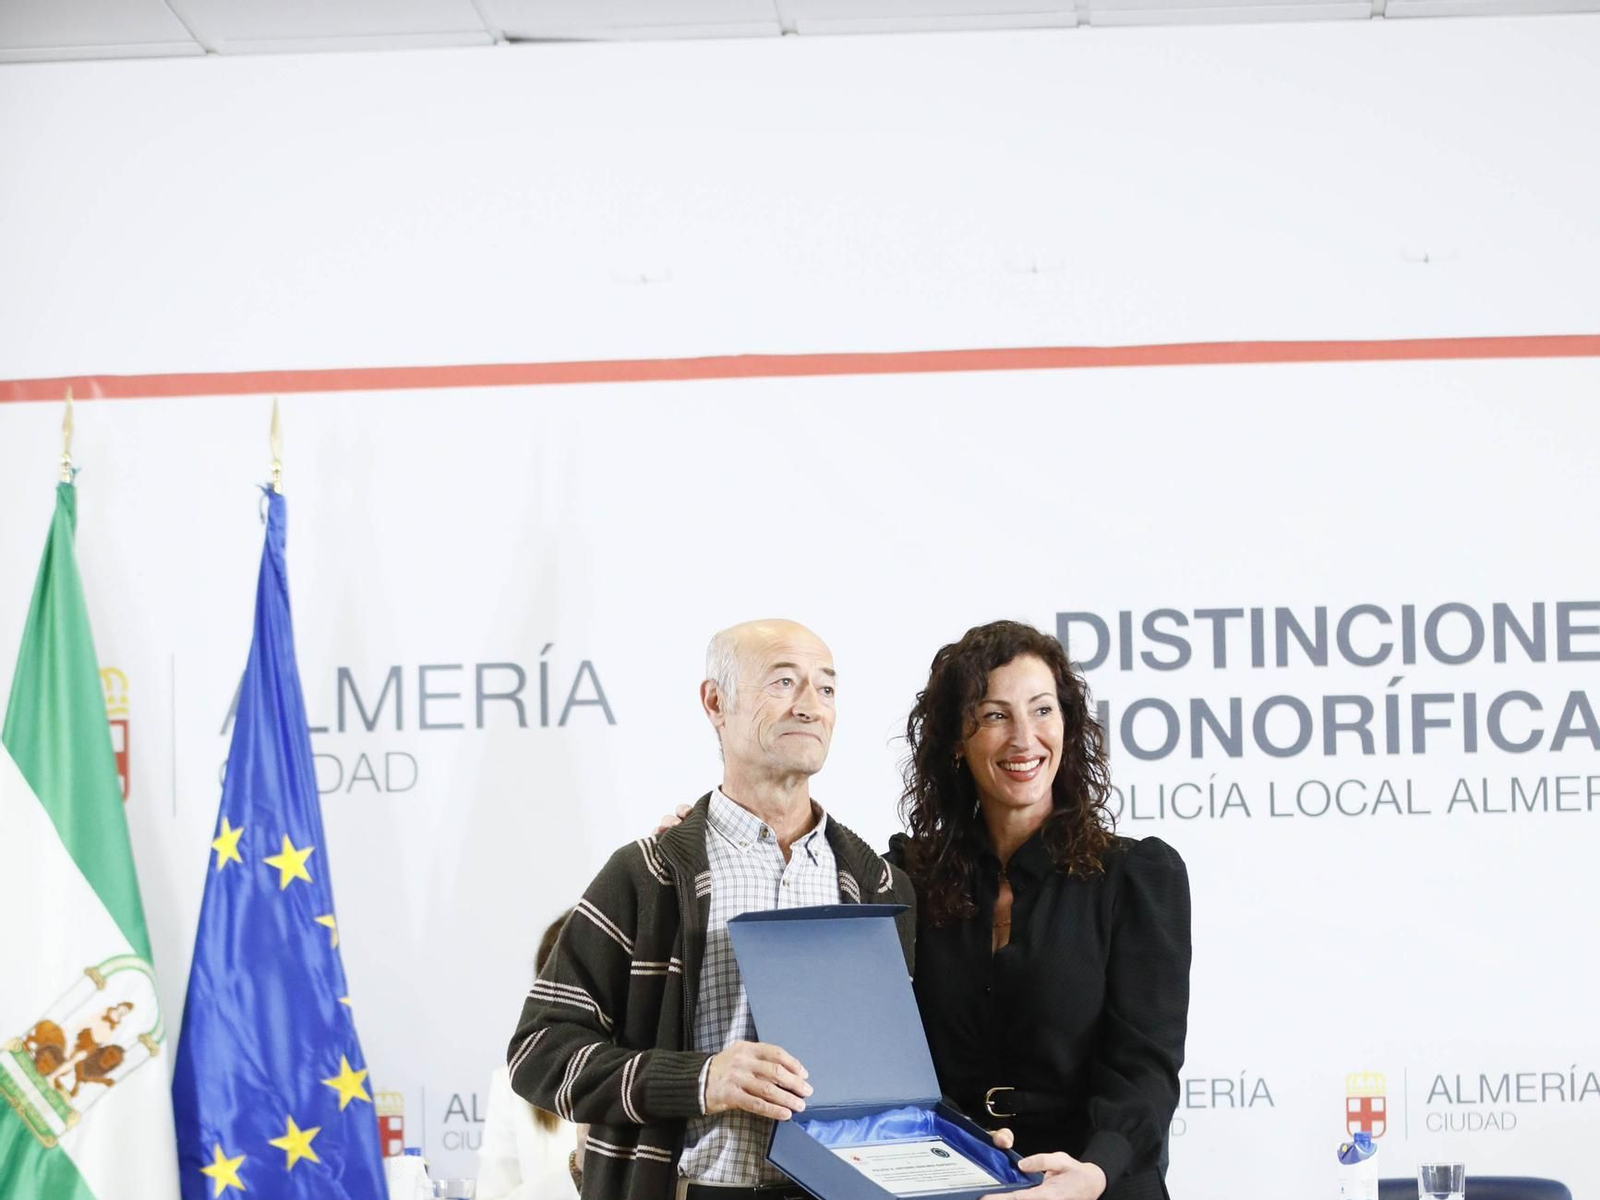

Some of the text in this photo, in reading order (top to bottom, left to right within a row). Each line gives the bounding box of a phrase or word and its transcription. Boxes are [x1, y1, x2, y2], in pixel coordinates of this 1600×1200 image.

[219, 643, 618, 736] MERÍA
[1269, 779, 1432, 818] LOCAL
[1426, 1064, 1600, 1104] ALMERÍA
[1426, 1111, 1518, 1132] CIUDAD
